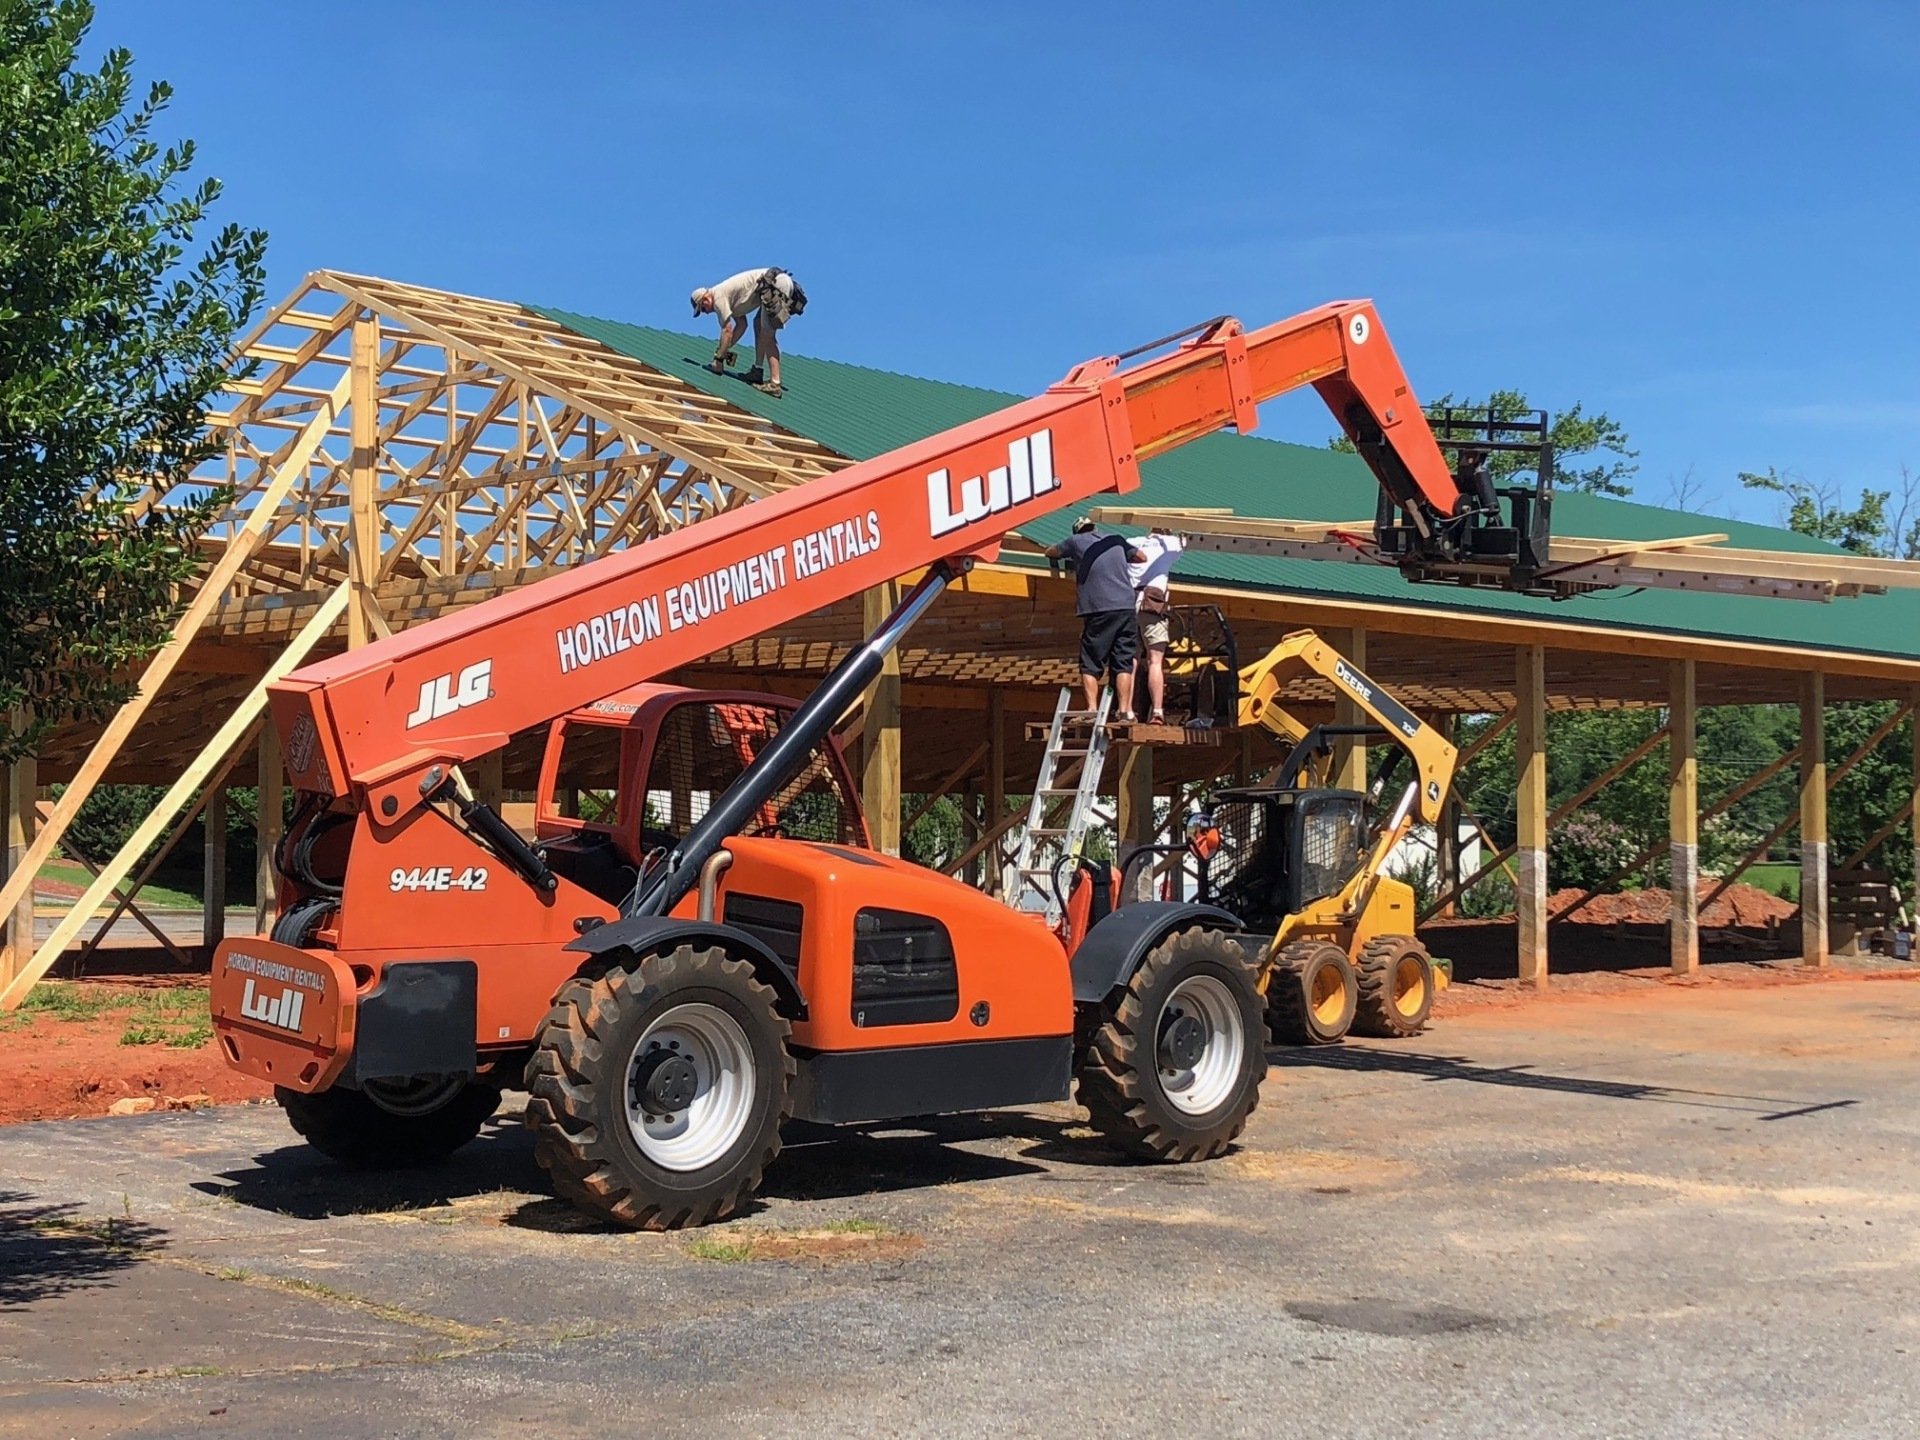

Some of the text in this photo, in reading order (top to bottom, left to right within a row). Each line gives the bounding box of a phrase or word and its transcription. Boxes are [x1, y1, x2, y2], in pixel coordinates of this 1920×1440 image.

[1355, 321, 1363, 337] 9
[926, 427, 1056, 540] Lull
[556, 509, 882, 675] HORIZON EQUIPMENT RENTALS
[405, 657, 493, 731] JLG
[388, 866, 489, 892] 944E-42
[228, 953, 325, 991] HORIZON EQUIPMENT RENTALS
[241, 979, 303, 1033] Lull
